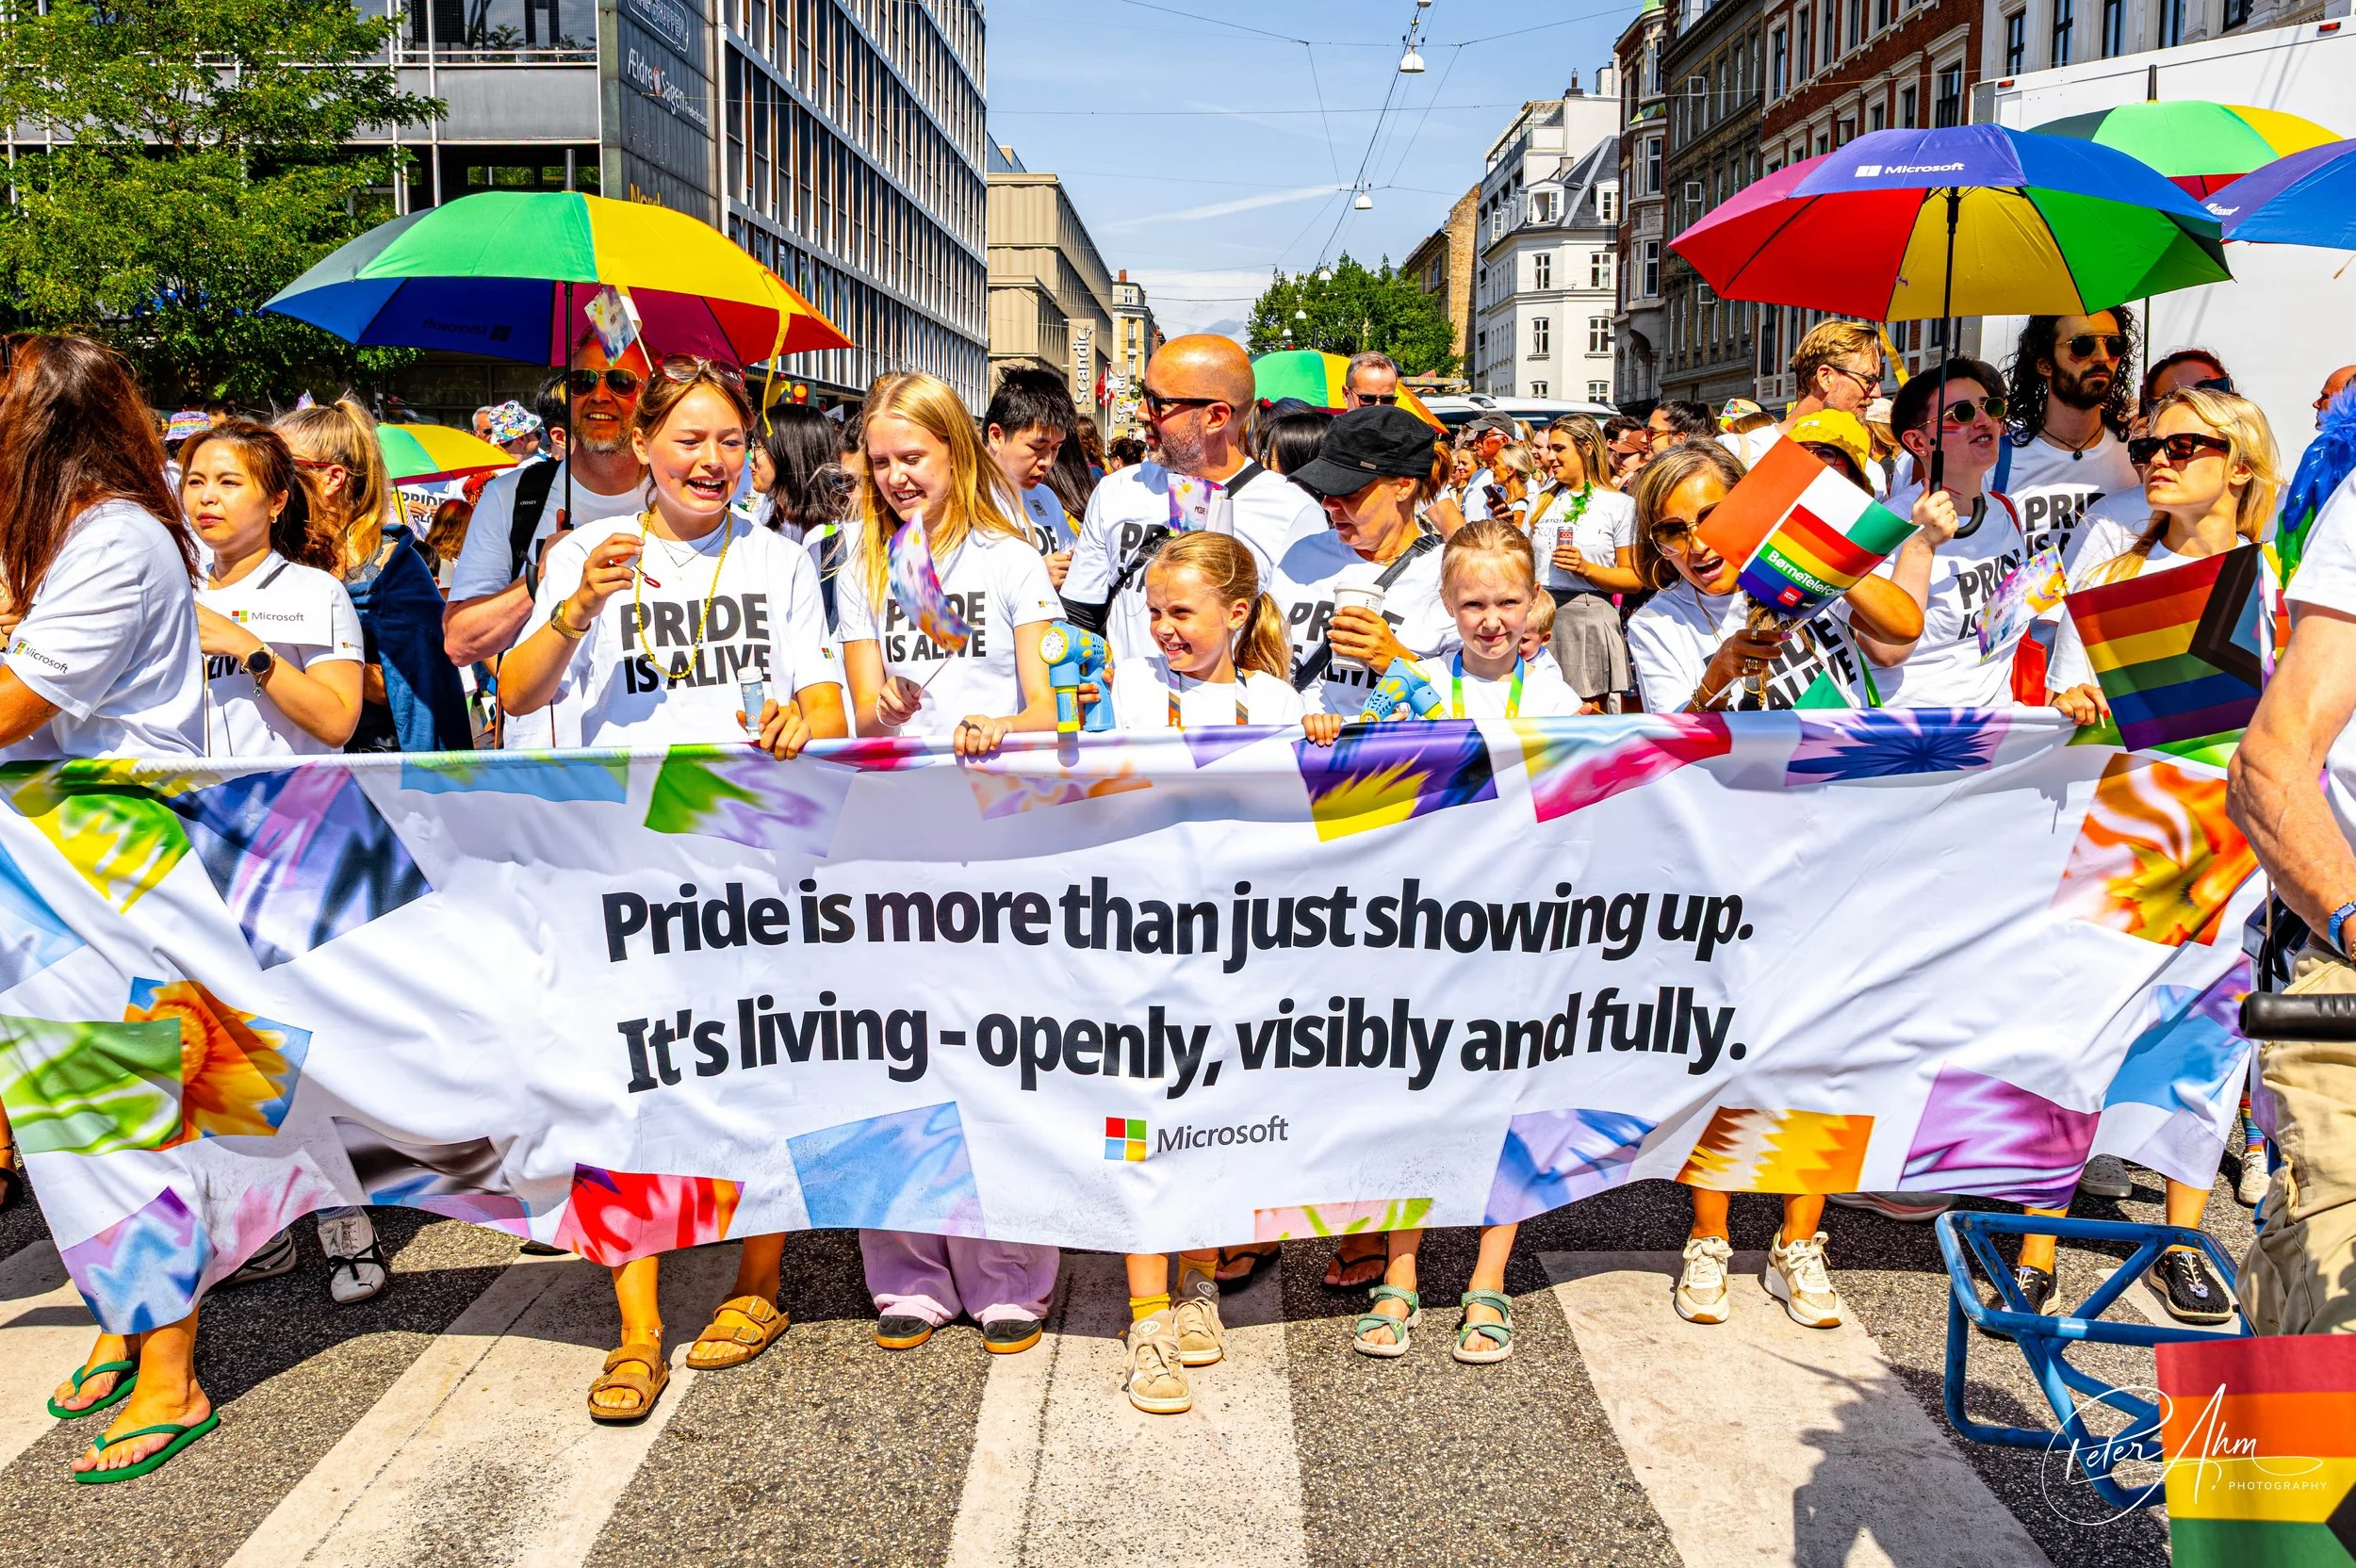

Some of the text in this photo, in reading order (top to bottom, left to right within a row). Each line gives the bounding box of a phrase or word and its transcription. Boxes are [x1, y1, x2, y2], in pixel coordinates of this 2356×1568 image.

[627, 47, 653, 90] Ældre
[661, 70, 685, 115] Sagen
[1884, 161, 1965, 174] Microsoft
[1072, 324, 1092, 405] Scandic
[251, 612, 305, 623] Microsoft
[620, 593, 770, 651] PRIDE
[23, 645, 70, 675] Microsoft
[623, 643, 772, 694] IS ALIVE
[886, 635, 907, 662] IS
[601, 876, 1755, 974] Pride is more than just showing up.
[616, 986, 1747, 1100] It's living - openly, visibly and fully.
[1157, 1115, 1289, 1153] Microsoft
